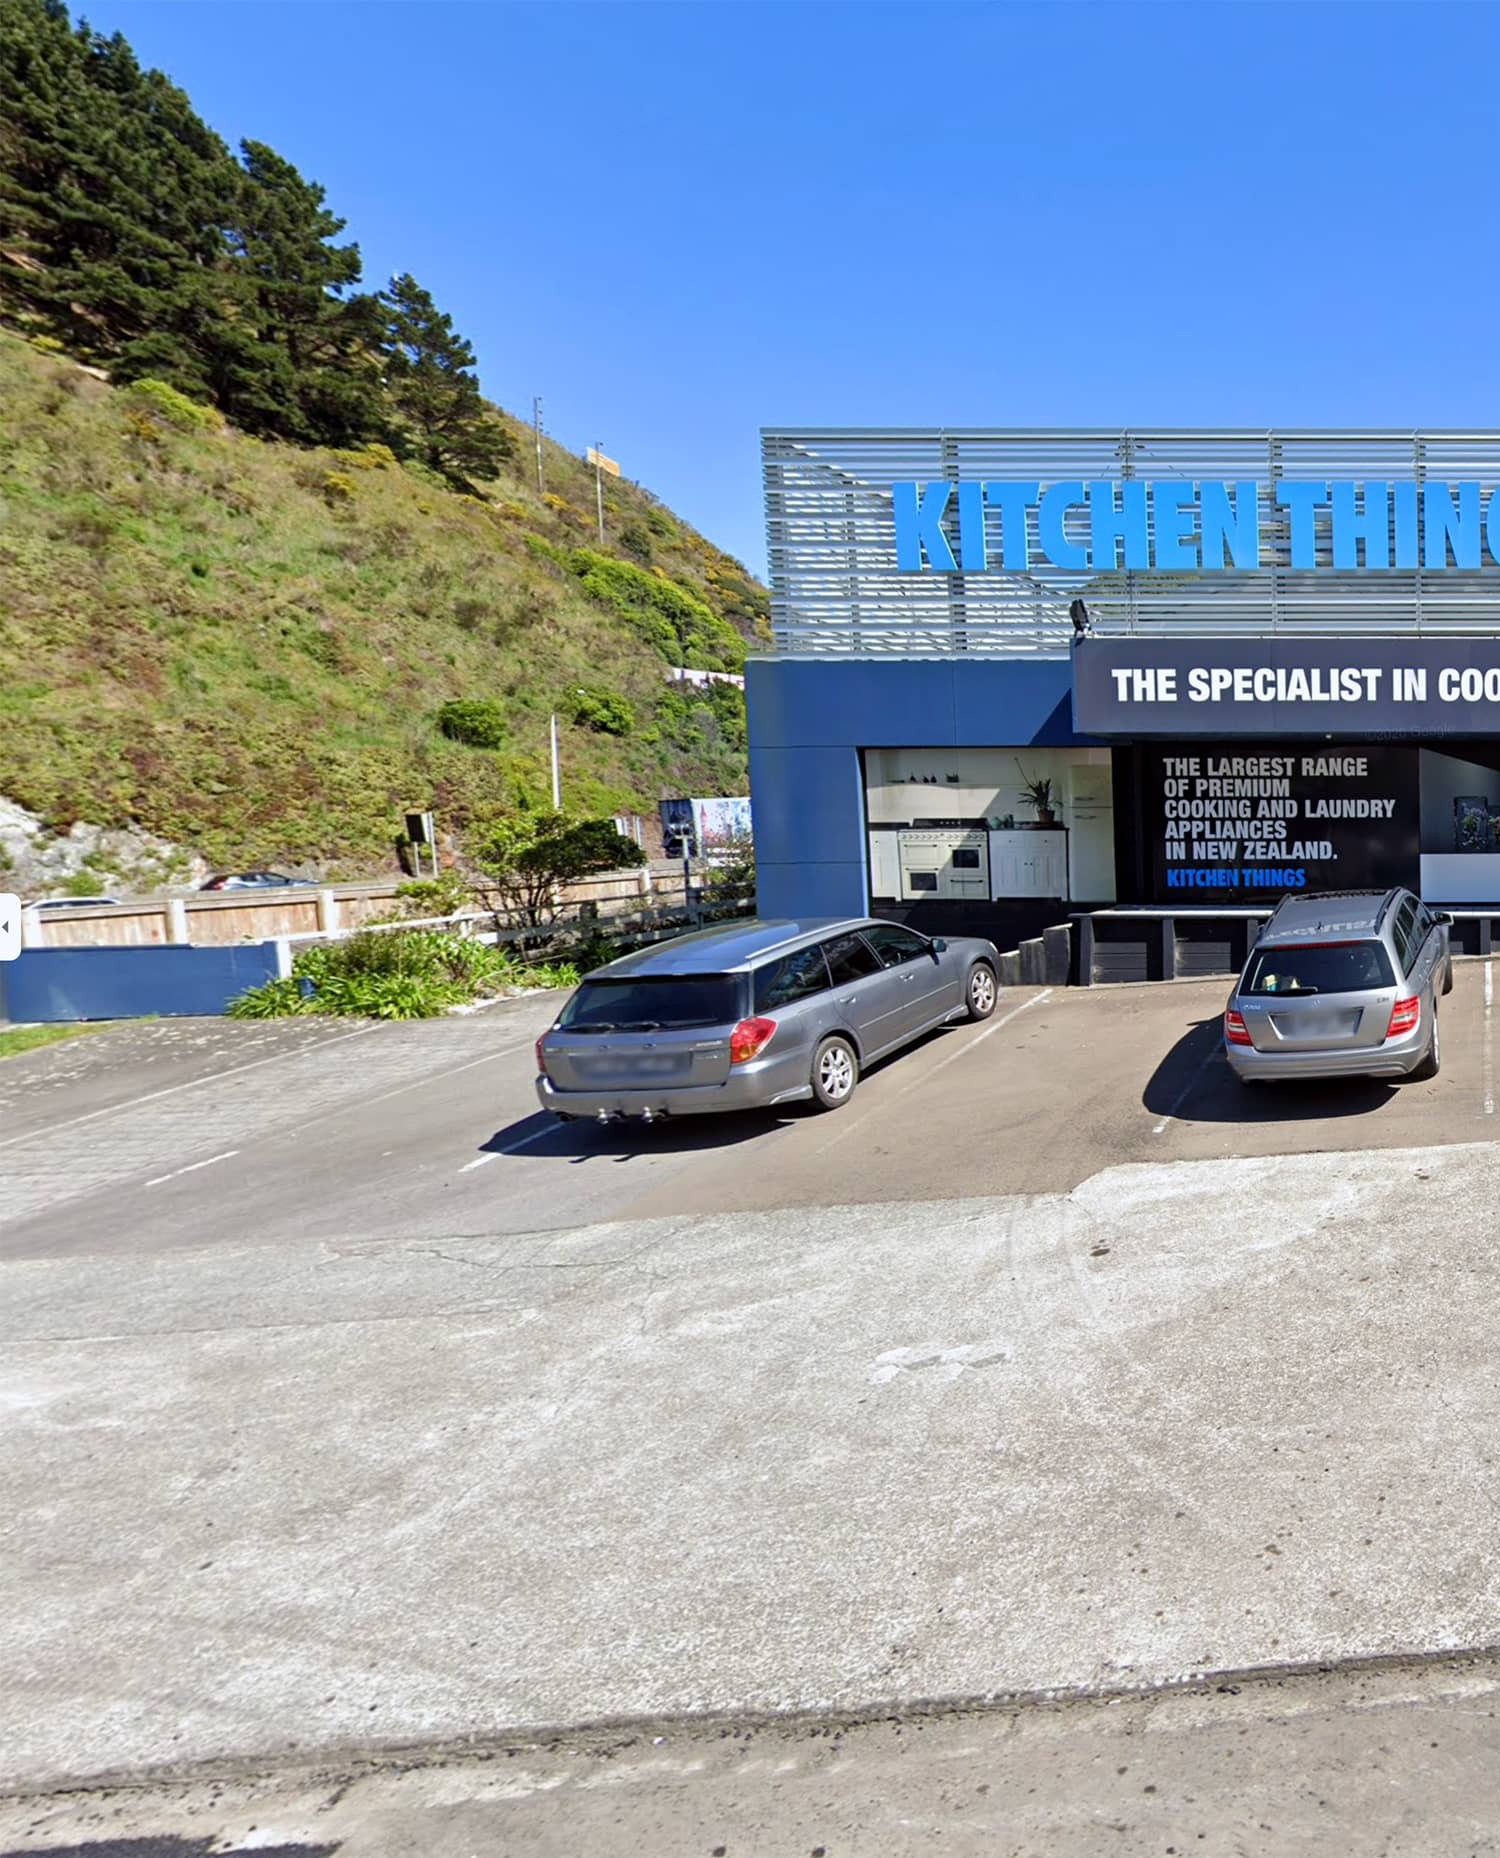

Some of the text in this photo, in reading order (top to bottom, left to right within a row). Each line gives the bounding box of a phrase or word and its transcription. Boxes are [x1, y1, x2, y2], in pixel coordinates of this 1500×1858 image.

[893, 481, 1260, 571] KITCHEN
[1111, 668, 1178, 702] THE
[1188, 667, 1383, 702] SPECIALIST
[1392, 668, 1427, 702] IN
[1163, 757, 1368, 777] THE LARGEST RANGE
[1164, 778, 1290, 798] OF PREMIUM
[1164, 799, 1396, 819] COOKING AND LAUNDRY
[1165, 820, 1288, 840] APPLIANCES
[1165, 840, 1338, 860] IN NEW ZEALAND.
[1167, 868, 1307, 888] KITCHEN THINGS
